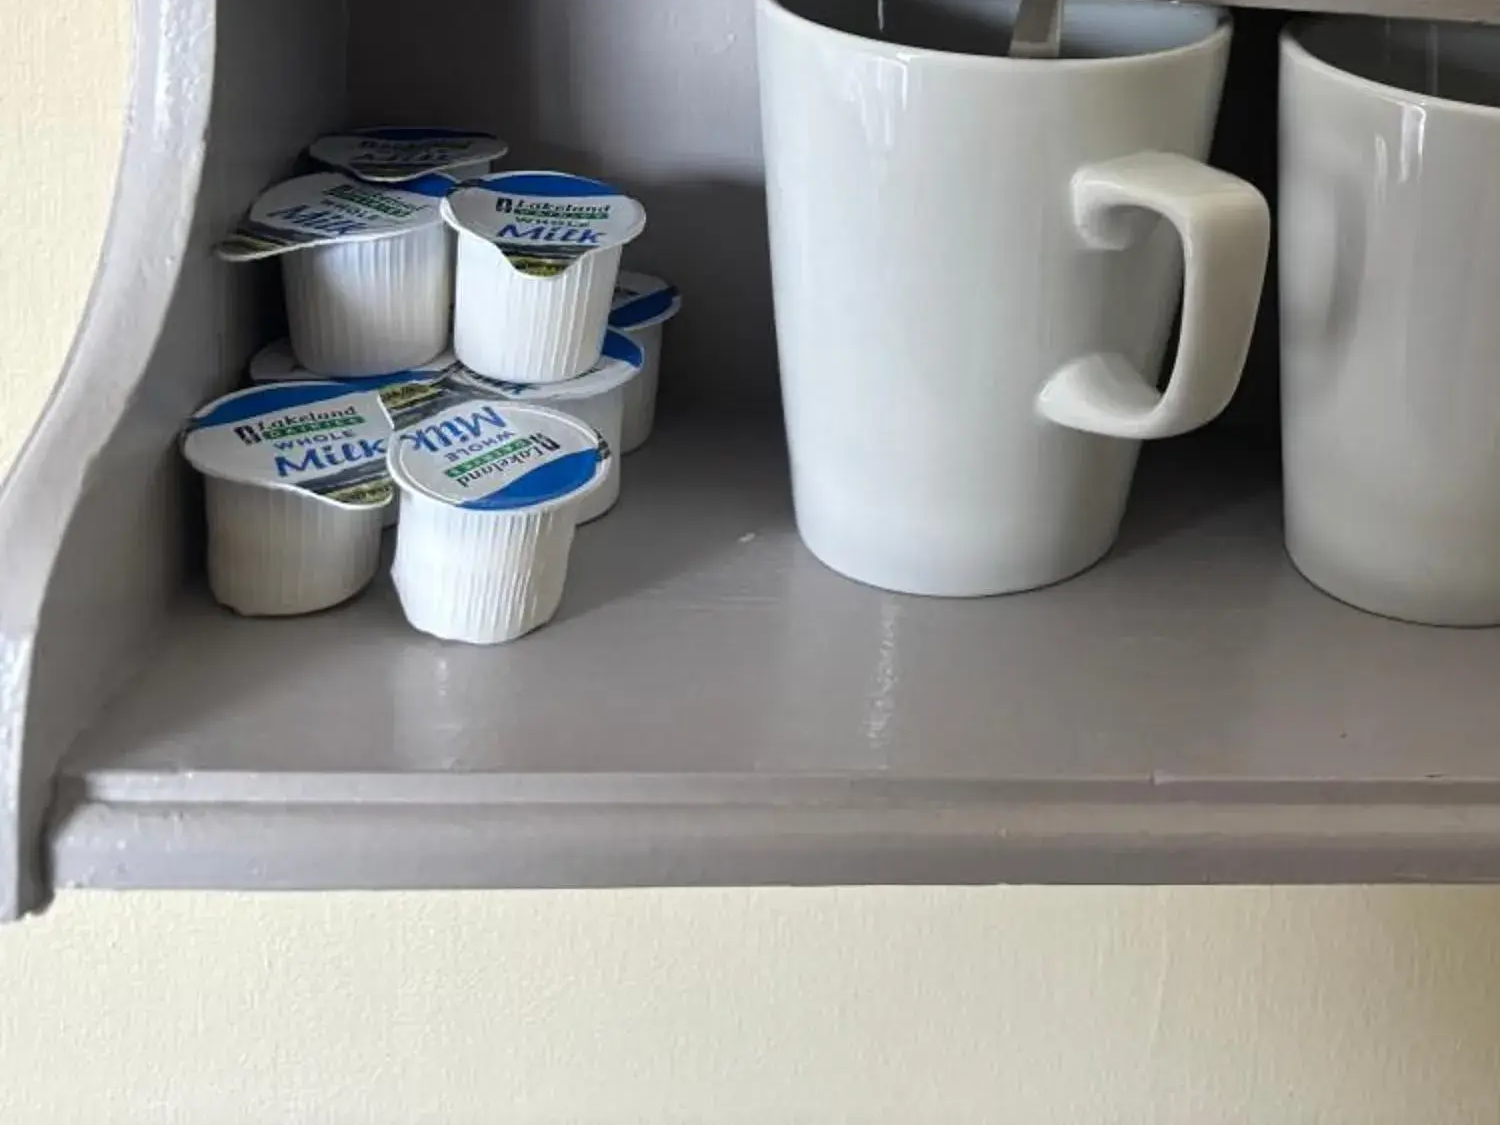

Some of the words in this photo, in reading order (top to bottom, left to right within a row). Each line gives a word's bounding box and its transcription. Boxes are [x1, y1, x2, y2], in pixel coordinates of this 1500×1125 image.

[496, 224, 608, 244] Milk
[257, 405, 357, 431] Lakeland
[399, 405, 507, 453] Milk
[272, 429, 355, 451] WHOLE
[444, 429, 516, 463] WHOLE
[273, 437, 388, 478] Milk
[455, 445, 544, 488] Lakeland
